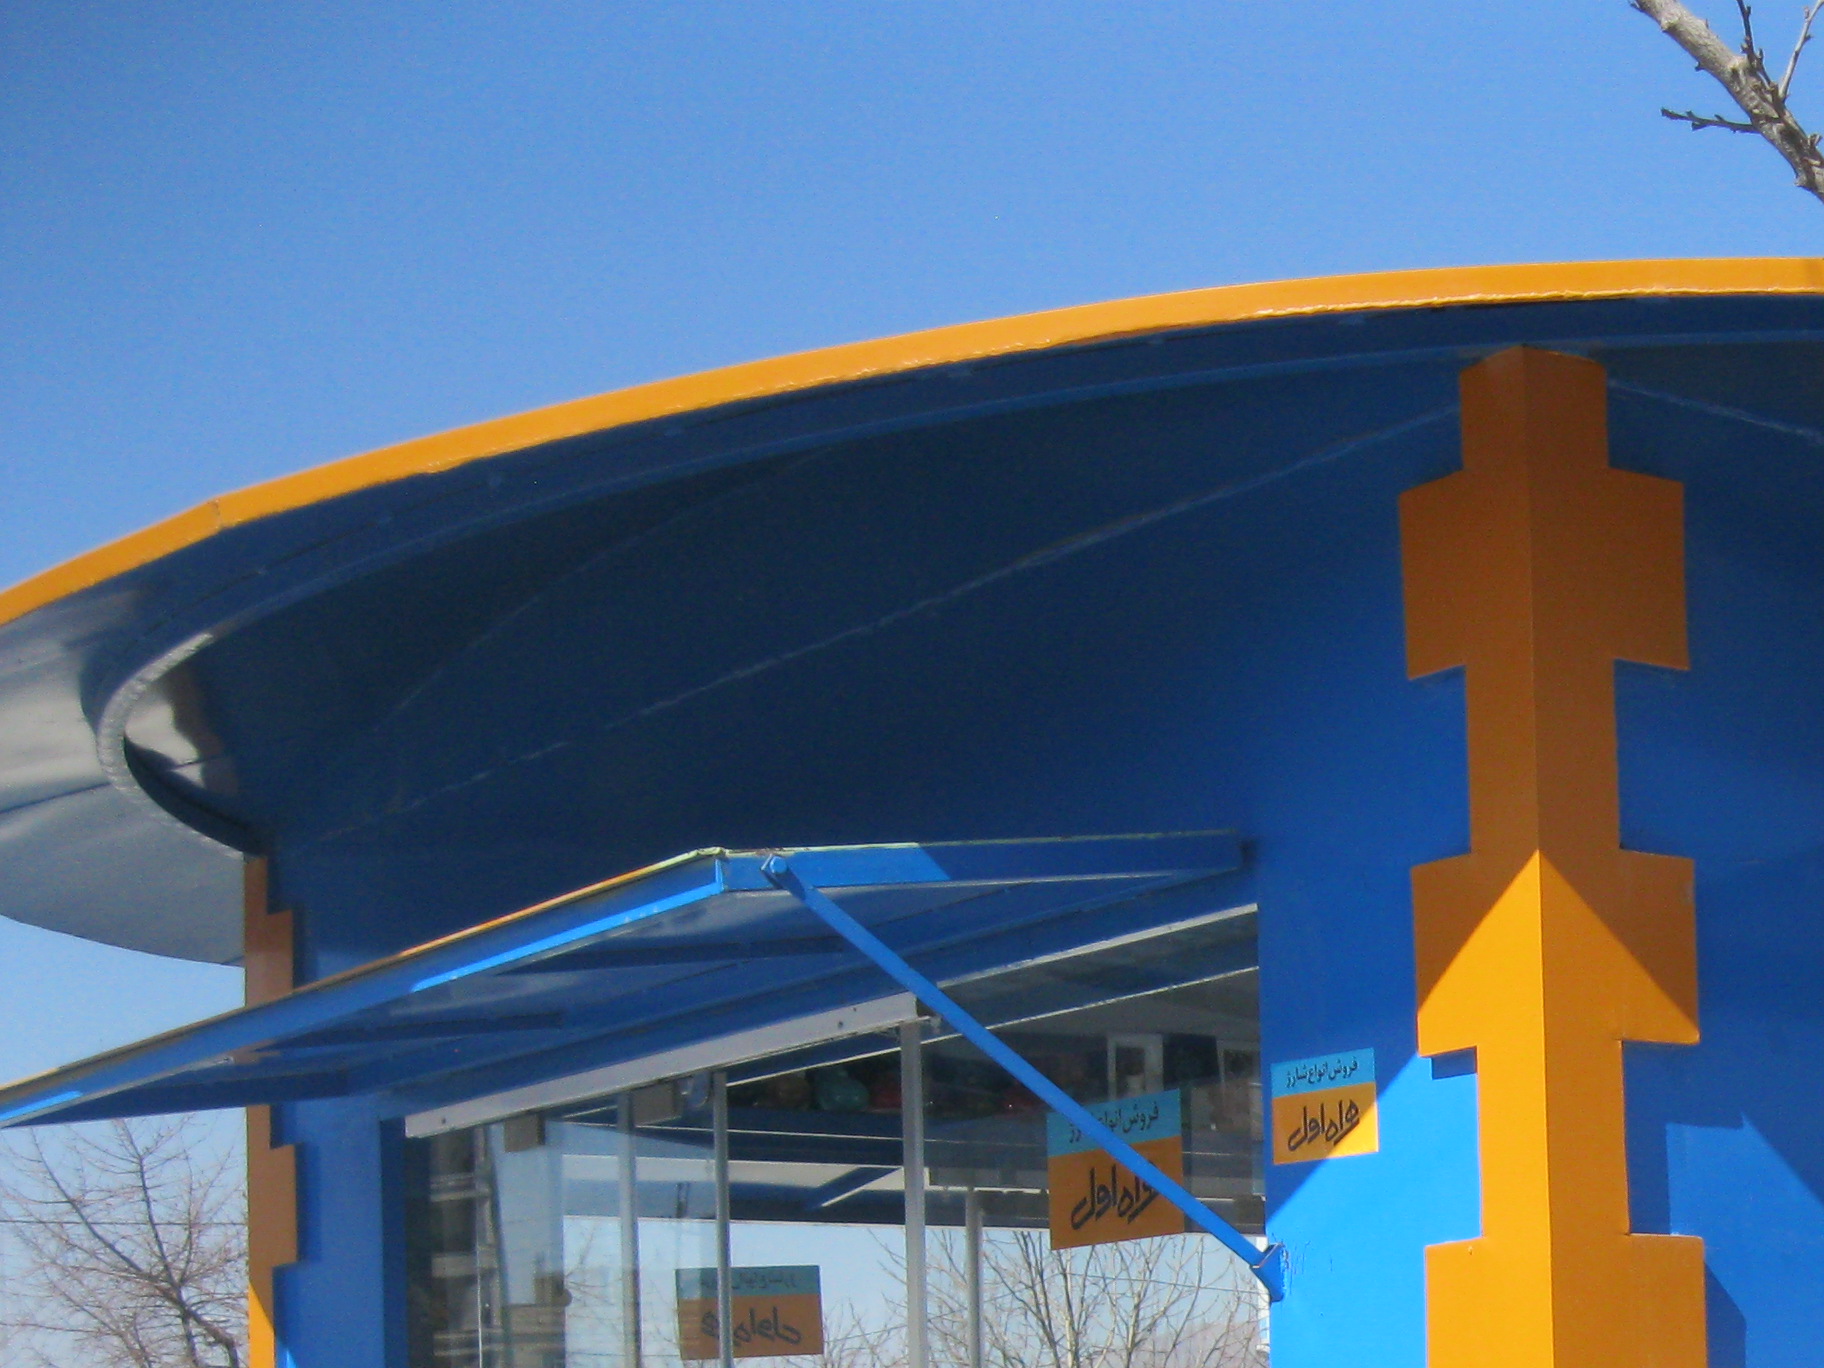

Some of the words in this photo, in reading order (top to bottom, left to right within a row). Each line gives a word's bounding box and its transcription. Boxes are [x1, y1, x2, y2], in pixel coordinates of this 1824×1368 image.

[1286, 1064, 1308, 1088] شارژ
[1307, 1061, 1328, 1084] انواع
[1328, 1056, 1358, 1080] فروش
[1123, 1101, 1160, 1133] فروش
[1288, 1102, 1324, 1152] اول
[1071, 1164, 1117, 1230] اول
